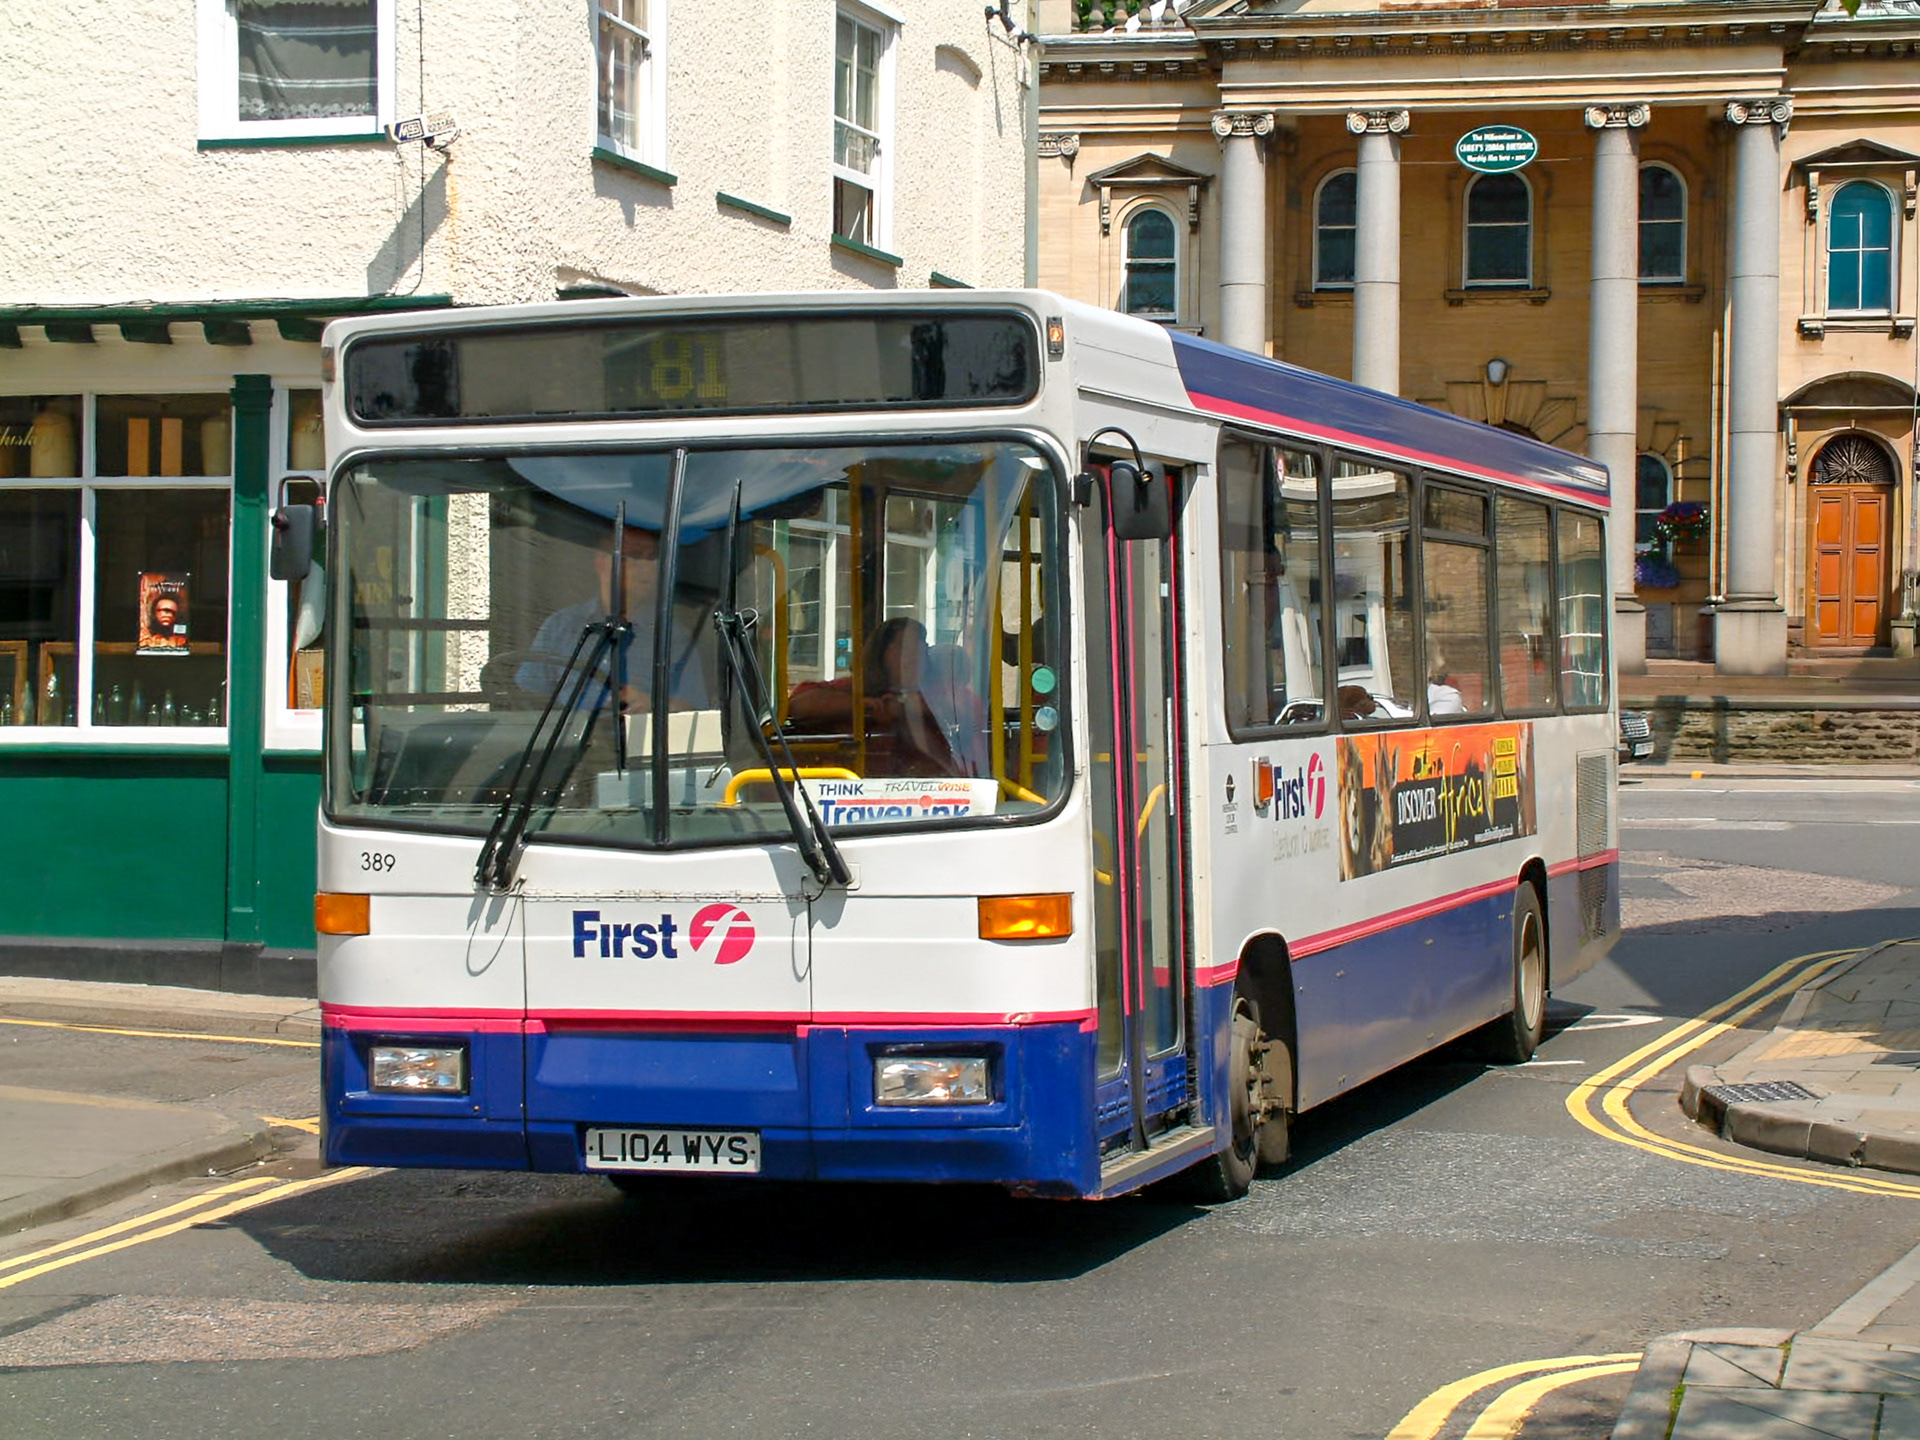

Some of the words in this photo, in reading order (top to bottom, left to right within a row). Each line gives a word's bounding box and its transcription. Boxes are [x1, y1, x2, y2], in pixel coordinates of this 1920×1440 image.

[818, 783, 864, 796] THINK
[1273, 766, 1306, 822] First
[361, 851, 396, 873] 389
[572, 910, 678, 959] First
[598, 1132, 672, 1163] L104
[682, 1134, 749, 1166] WYS
